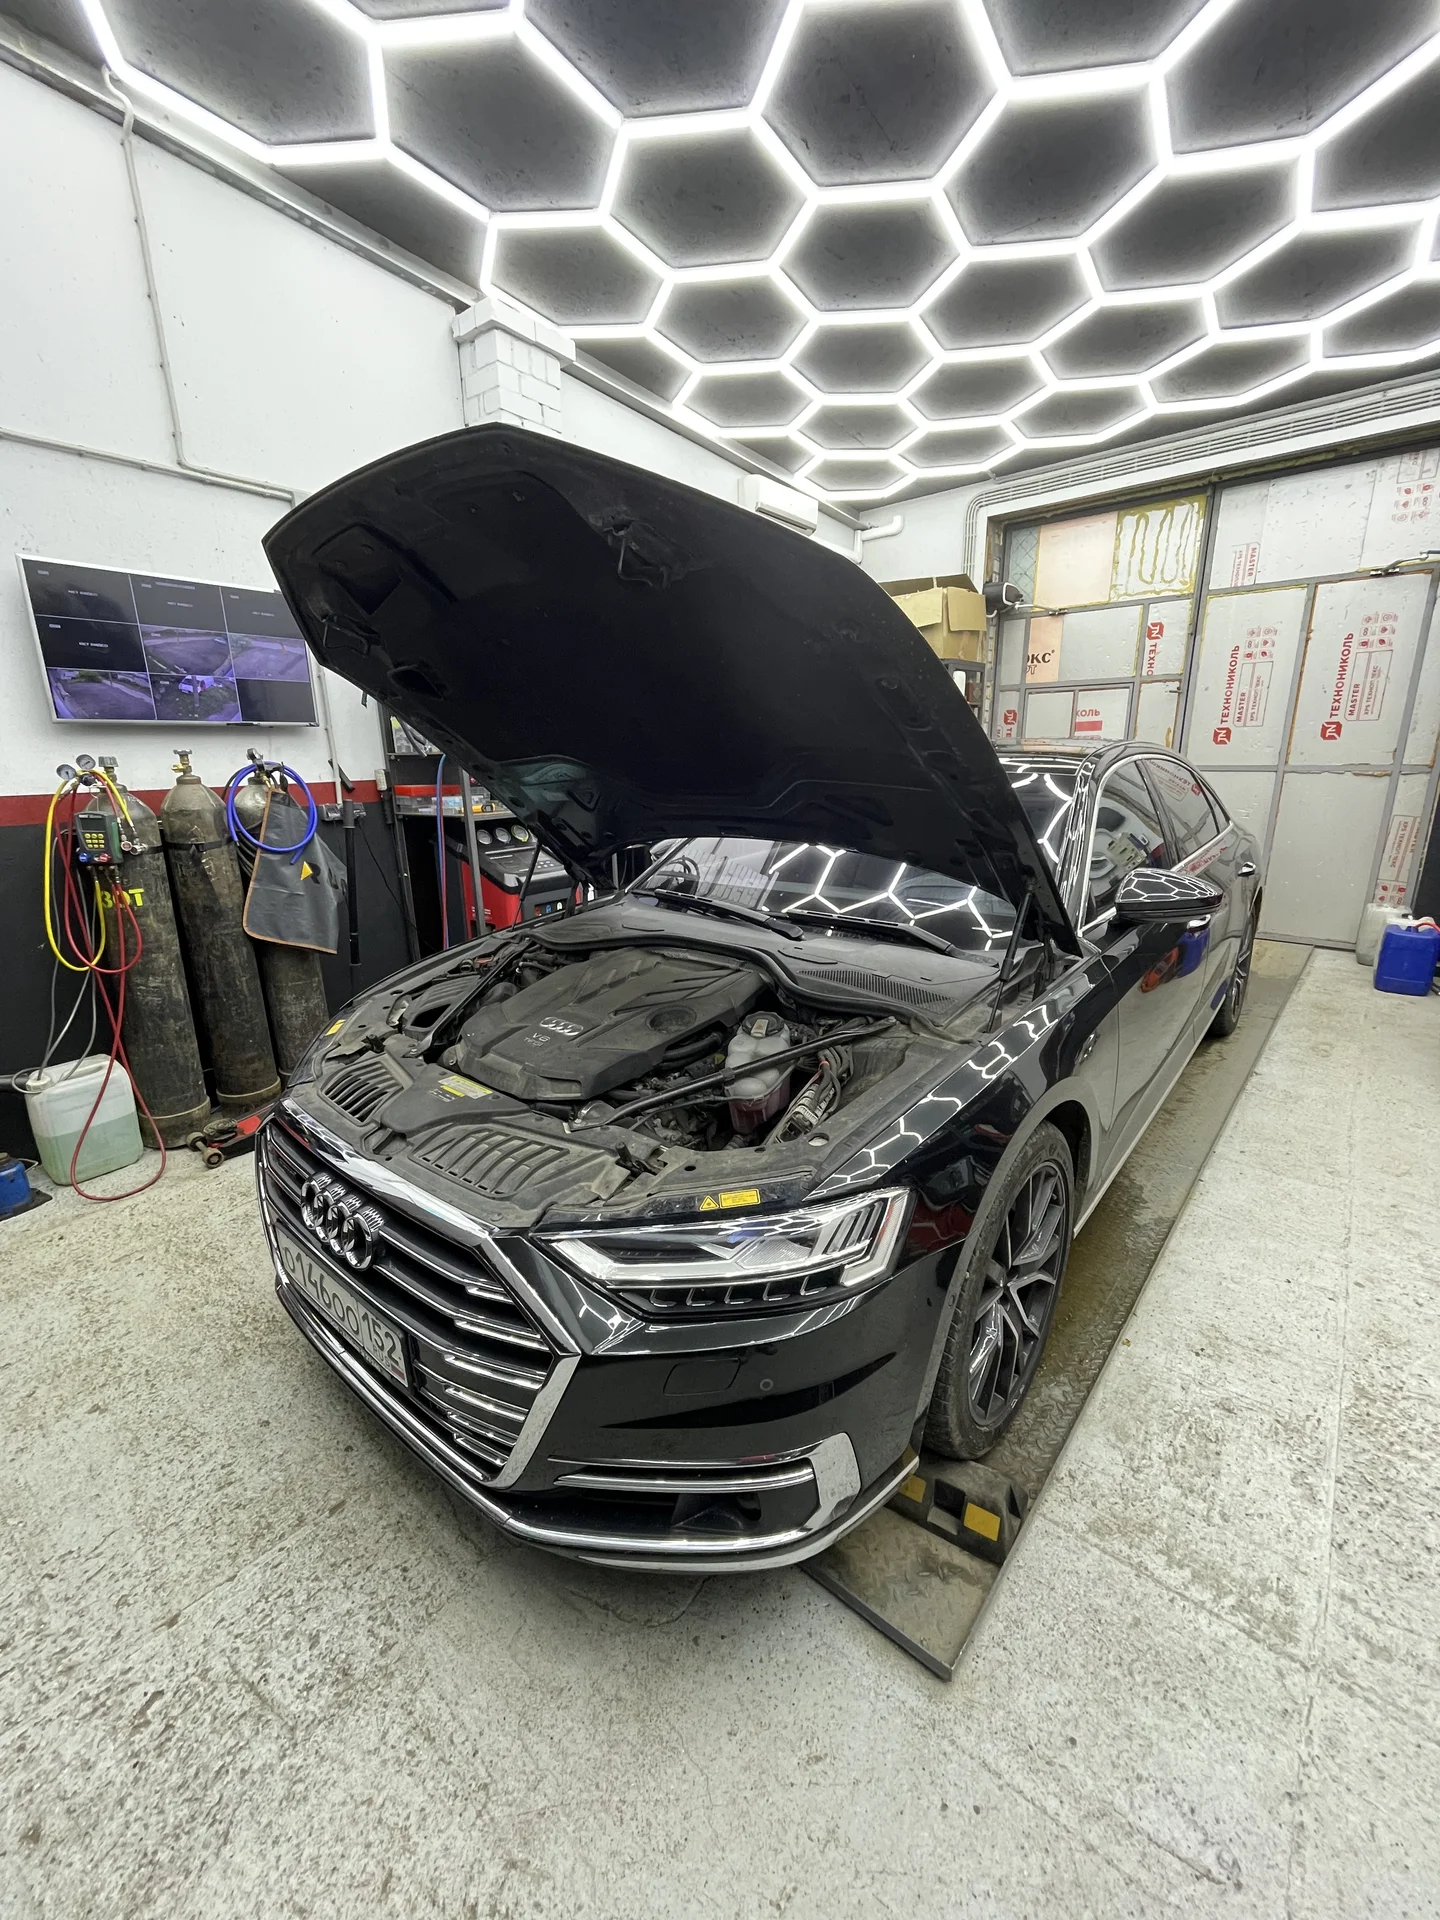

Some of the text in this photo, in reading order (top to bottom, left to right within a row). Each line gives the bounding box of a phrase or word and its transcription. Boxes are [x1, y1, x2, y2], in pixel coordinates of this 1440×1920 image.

[1247, 547, 1257, 577] MASTER
[1220, 645, 1240, 724] ТЕХНОНИКОЛЬ
[1330, 632, 1354, 719] ТЕХНОНИКОЛЬ
[1236, 692, 1246, 722] MASTER
[1348, 683, 1361, 716] MASTER
[533, 1032, 550, 1042] V6
[362, 1311, 399, 1366] 152
[373, 1346, 391, 1368] RUS
